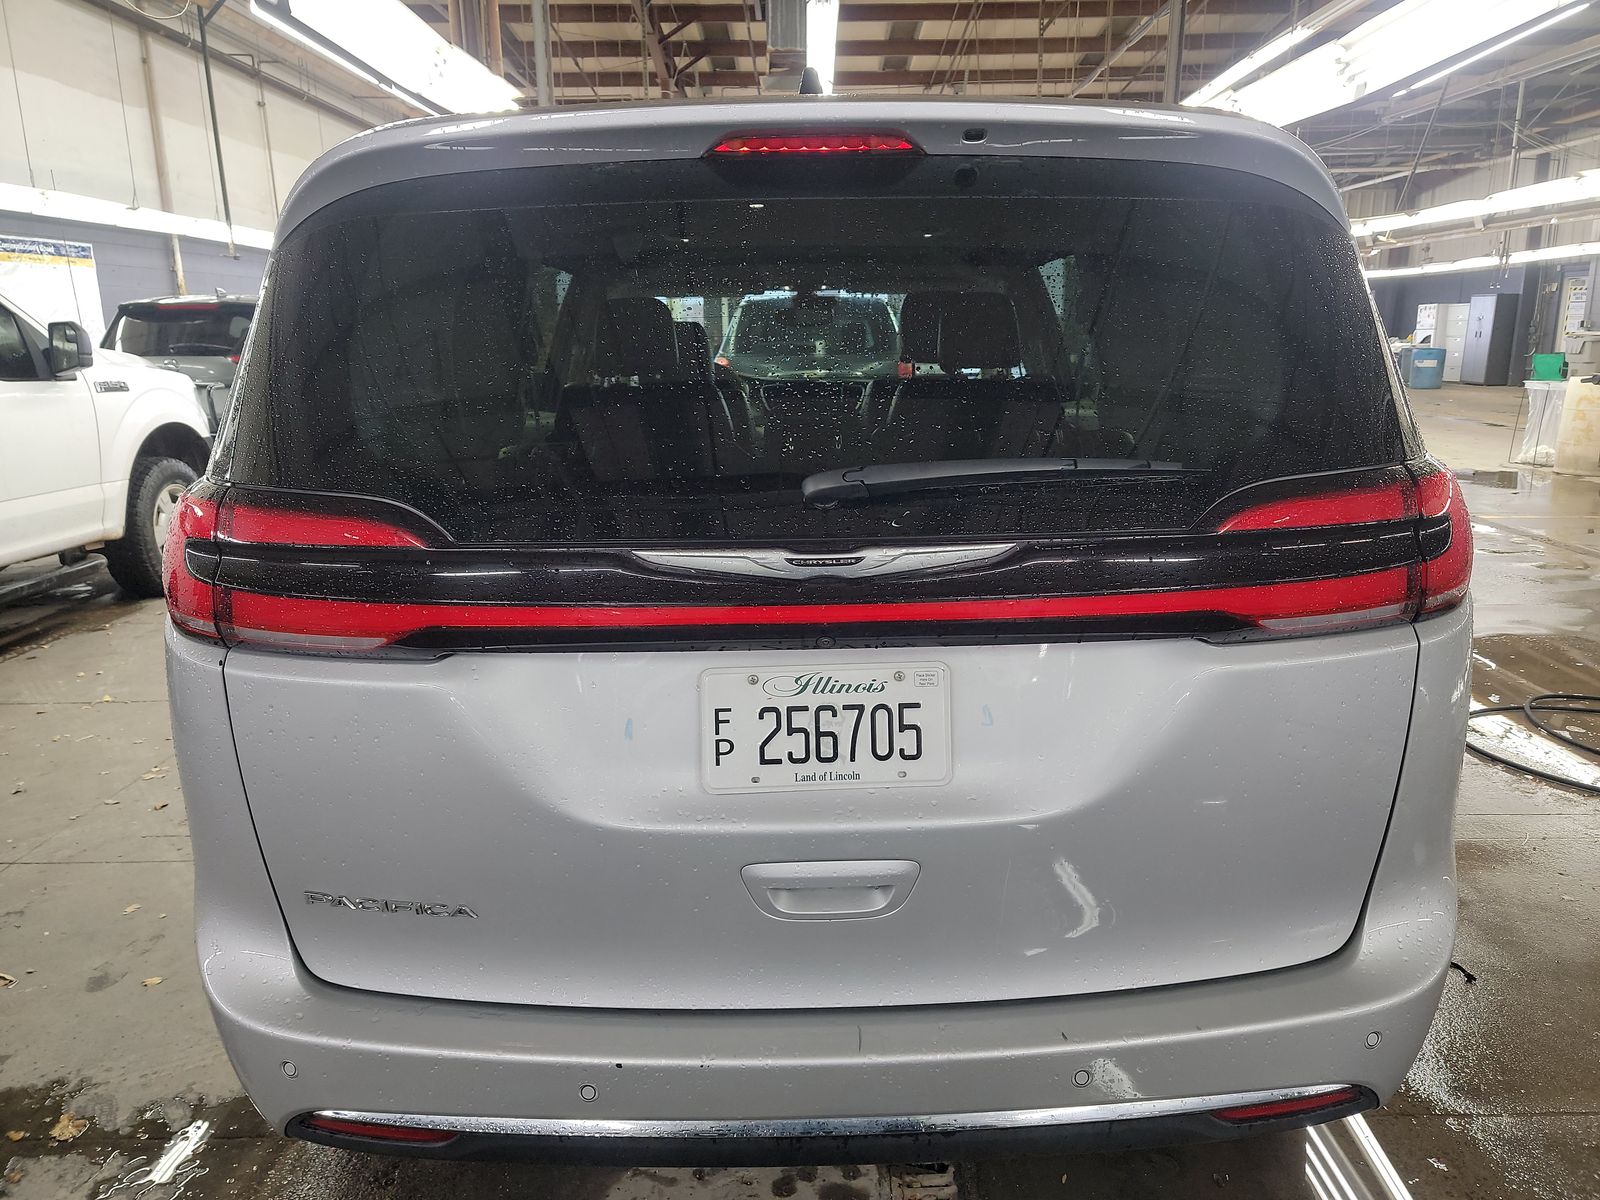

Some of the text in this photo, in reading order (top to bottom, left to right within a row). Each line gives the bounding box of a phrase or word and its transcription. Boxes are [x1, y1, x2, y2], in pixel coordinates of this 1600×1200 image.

[762, 671, 889, 700] Illinois
[758, 702, 923, 766] 256705
[795, 771, 861, 783] Land of Lincoln
[304, 890, 480, 919] PACIFICA
